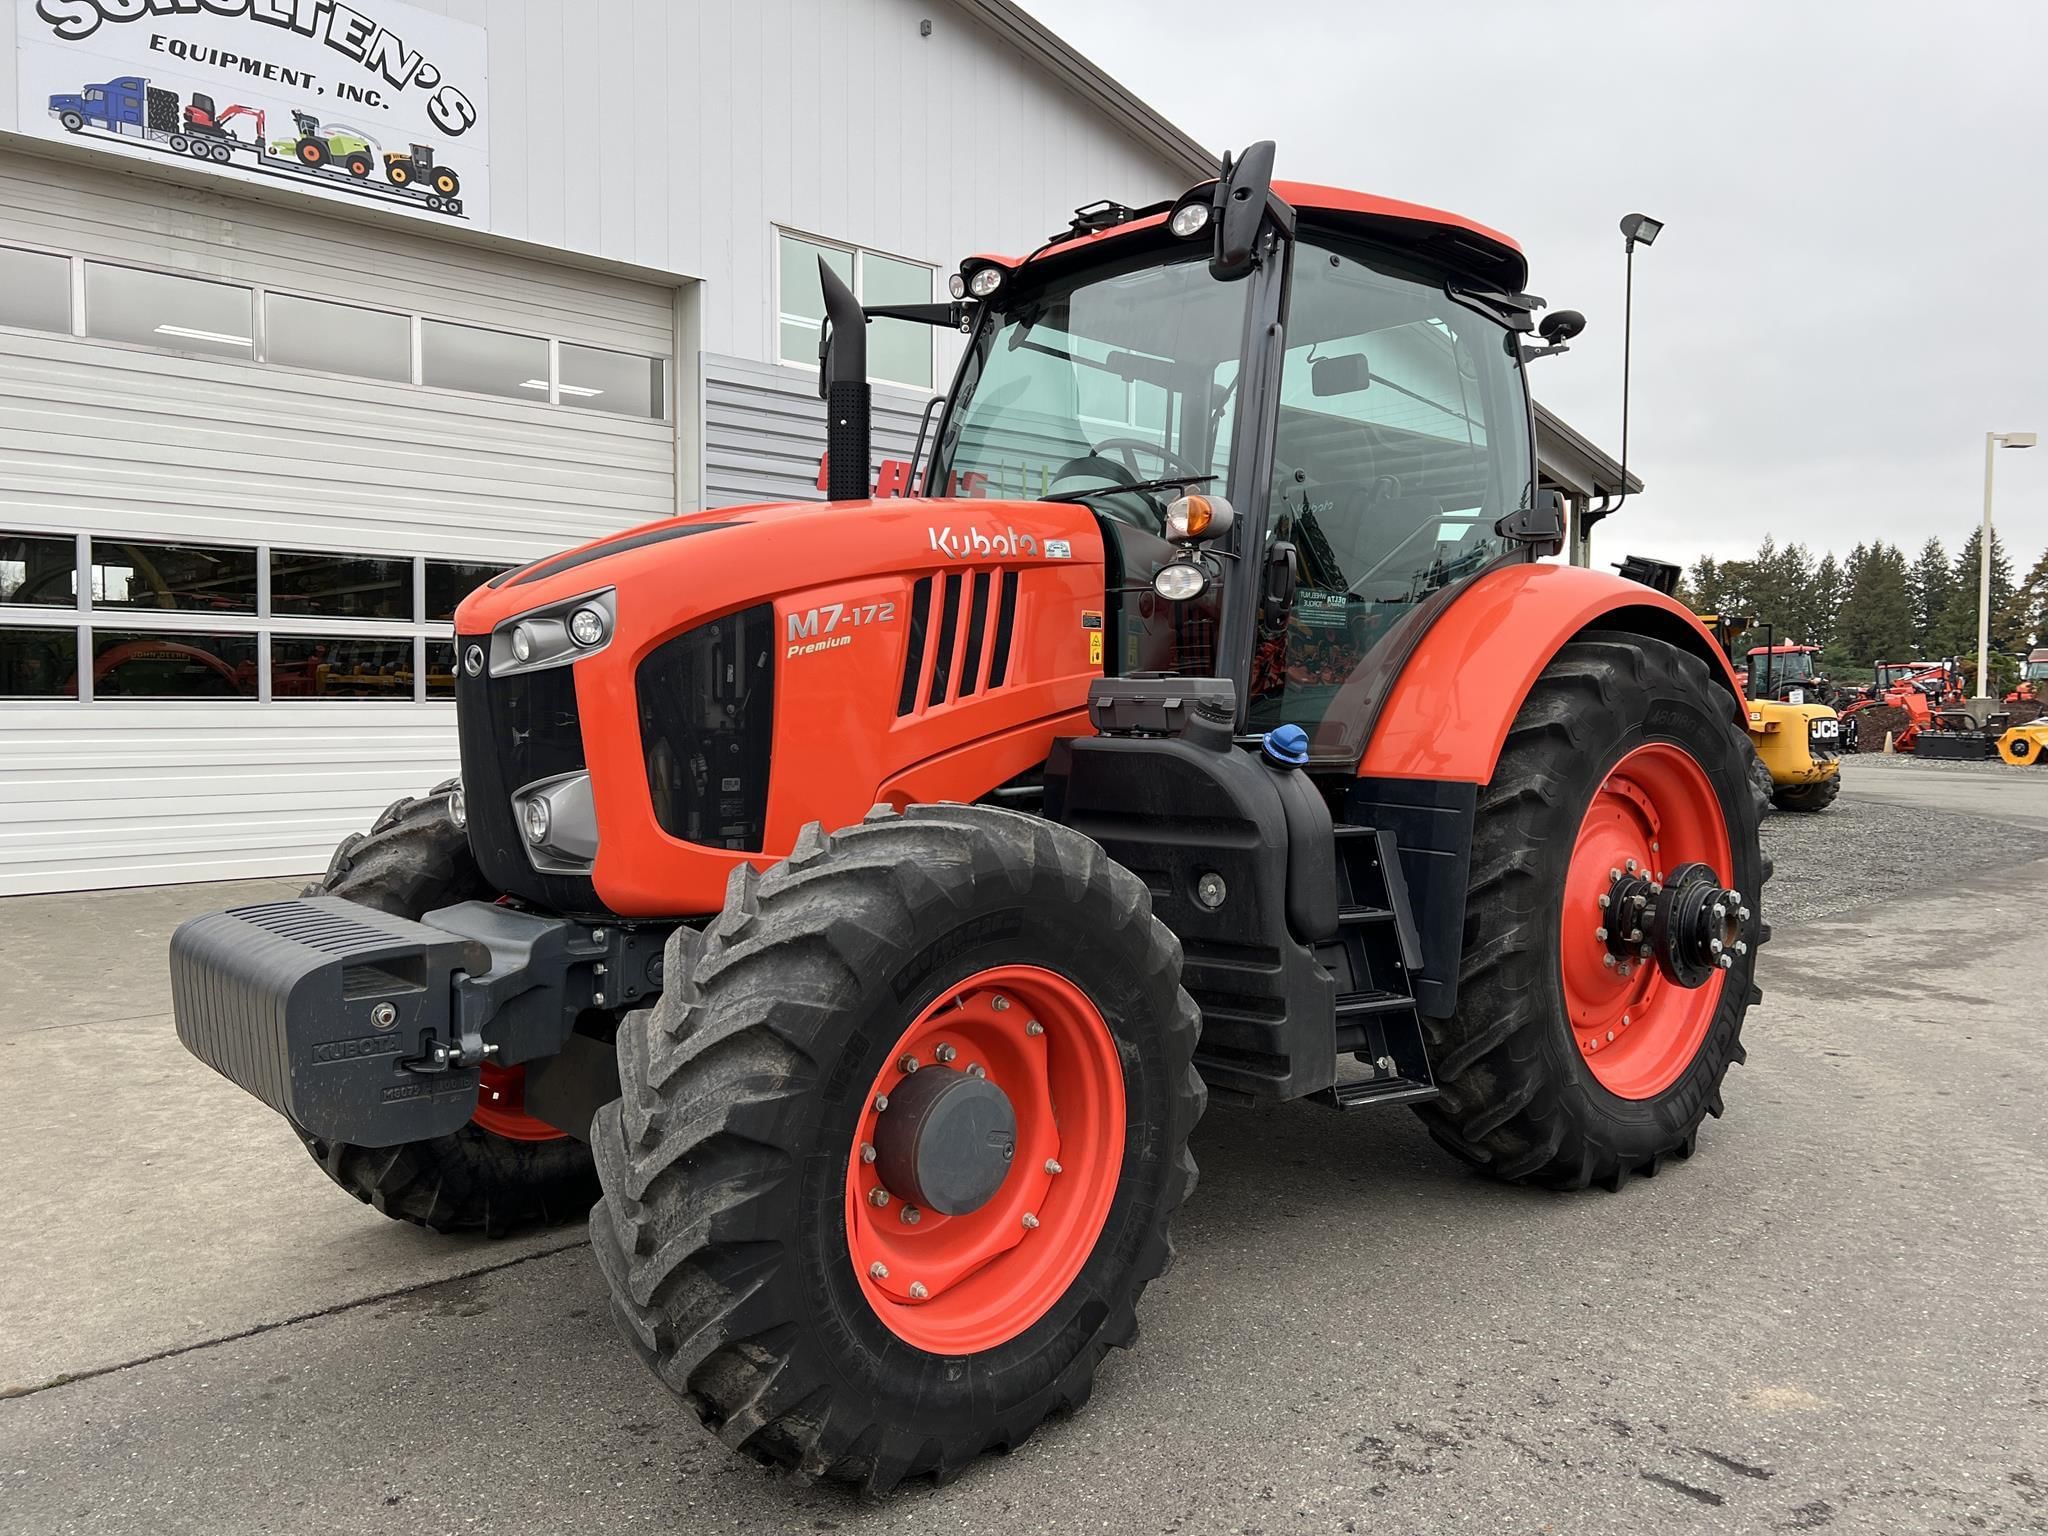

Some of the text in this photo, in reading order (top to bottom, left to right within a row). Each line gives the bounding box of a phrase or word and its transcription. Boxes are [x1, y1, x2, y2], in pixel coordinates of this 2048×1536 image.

[149, 33, 390, 110] EQUIPMENT, INC.
[928, 526, 1038, 559] Kubota
[787, 602, 895, 642] M7-172
[787, 635, 851, 659] Premium
[1812, 720, 1839, 739] JCB
[313, 1035, 400, 1062] KUBOTA
